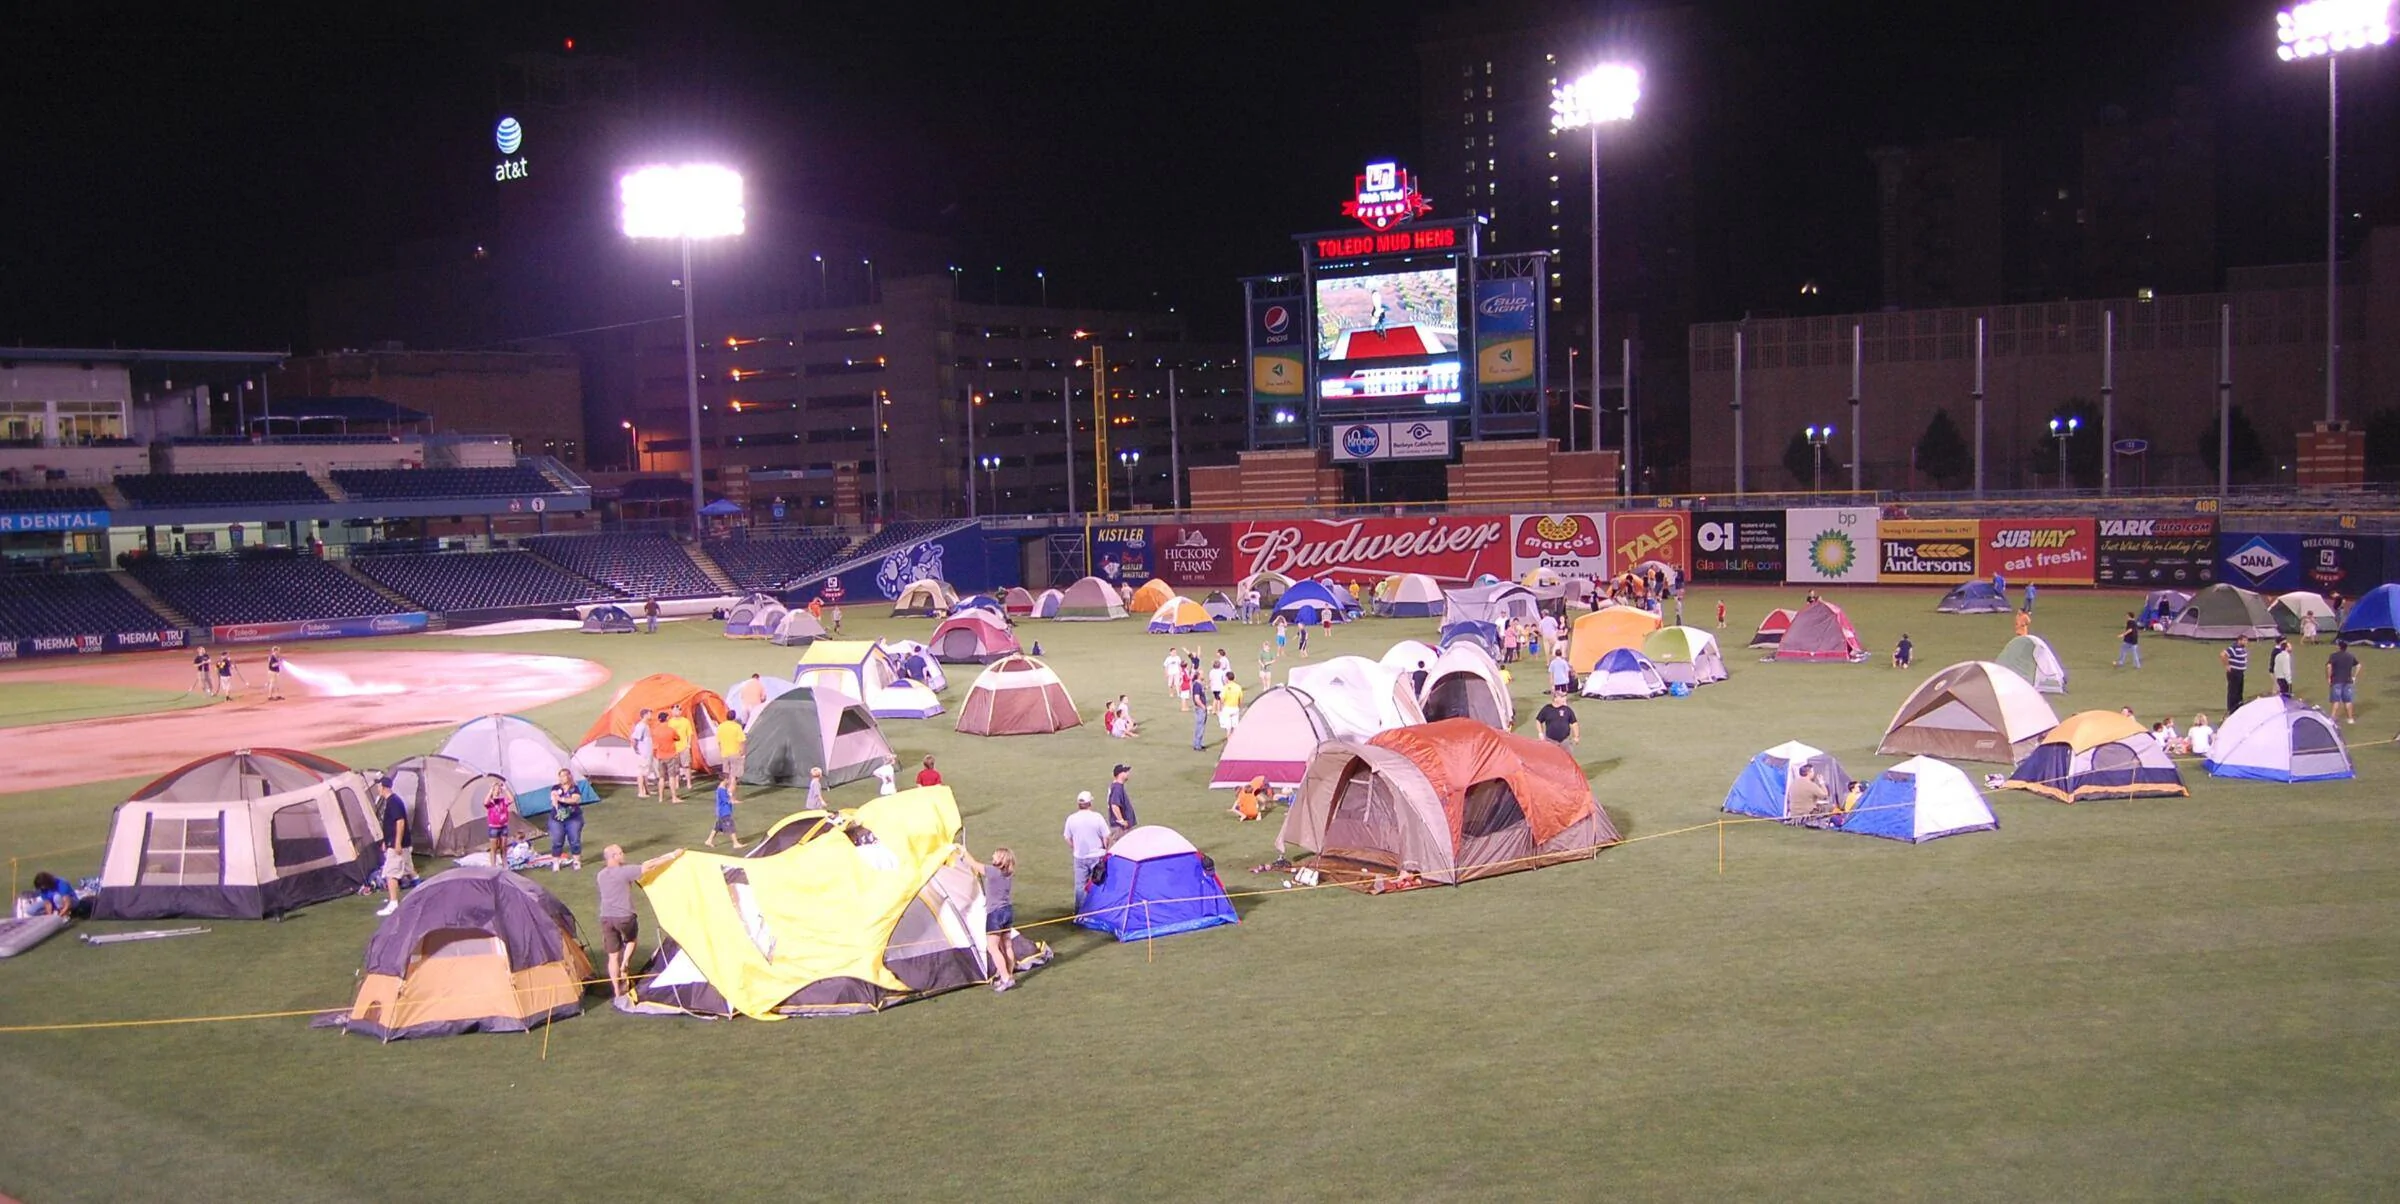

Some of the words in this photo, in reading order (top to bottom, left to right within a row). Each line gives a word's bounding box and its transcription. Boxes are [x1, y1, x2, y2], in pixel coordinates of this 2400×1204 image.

[495, 157, 528, 181] at&t
[1357, 203, 1404, 217] FIELD
[1317, 236, 1374, 257] TOLEDO
[1376, 233, 1411, 252] MUD
[1414, 228, 1455, 249] HENS
[1486, 304, 1529, 313] LIGHT
[1494, 297, 1527, 306] BUD
[1266, 334, 1289, 344] pepsi
[1347, 430, 1377, 453] Kroger
[20, 514, 97, 529] DENTAL
[1838, 511, 1857, 526] bp
[2100, 519, 2155, 536] YARK
[1098, 528, 1144, 542] KISTLER
[1617, 518, 1679, 562] TAS
[1991, 529, 2076, 548] SUBWAY
[1237, 517, 1501, 575] Budweiser
[1884, 542, 1914, 557] The
[2101, 541, 2118, 551] Just
[2120, 541, 2140, 551] What
[2163, 541, 2191, 554] Looking
[2303, 538, 2340, 548] WELCOME
[2344, 540, 2354, 550] TO
[1165, 548, 1220, 560] HICKORY
[2240, 555, 2274, 567] DANA
[1174, 561, 1213, 573] FARMS
[1540, 558, 1580, 568] Pizza
[1696, 559, 1782, 571] GlassIsLife.com
[1884, 559, 1971, 572] Andersons
[2005, 557, 2032, 571] eat
[234, 629, 258, 637] Toledo
[308, 623, 330, 631] Toledo
[34, 637, 77, 650] THERMA
[84, 635, 102, 647] TRU
[118, 631, 160, 644] THERMA
[165, 630, 184, 641] TRU
